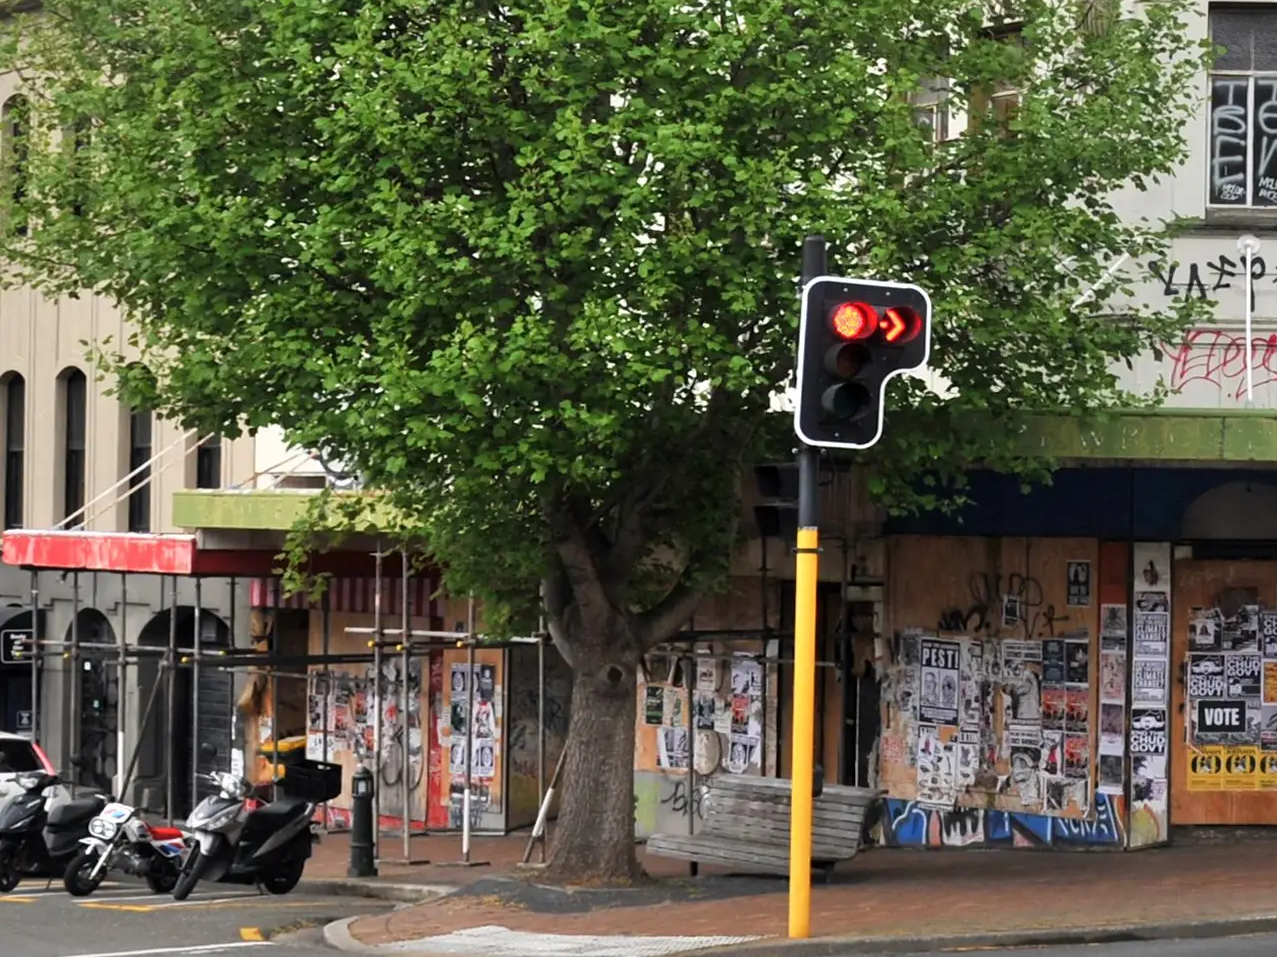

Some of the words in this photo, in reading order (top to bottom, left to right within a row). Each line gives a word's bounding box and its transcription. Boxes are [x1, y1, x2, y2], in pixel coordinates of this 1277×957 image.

[921, 647, 960, 669] PEST!
[1227, 668, 1260, 677] GOVT
[1190, 688, 1223, 696] GOVT
[1204, 708, 1240, 726] VOTE
[1130, 743, 1164, 752] GOVT
